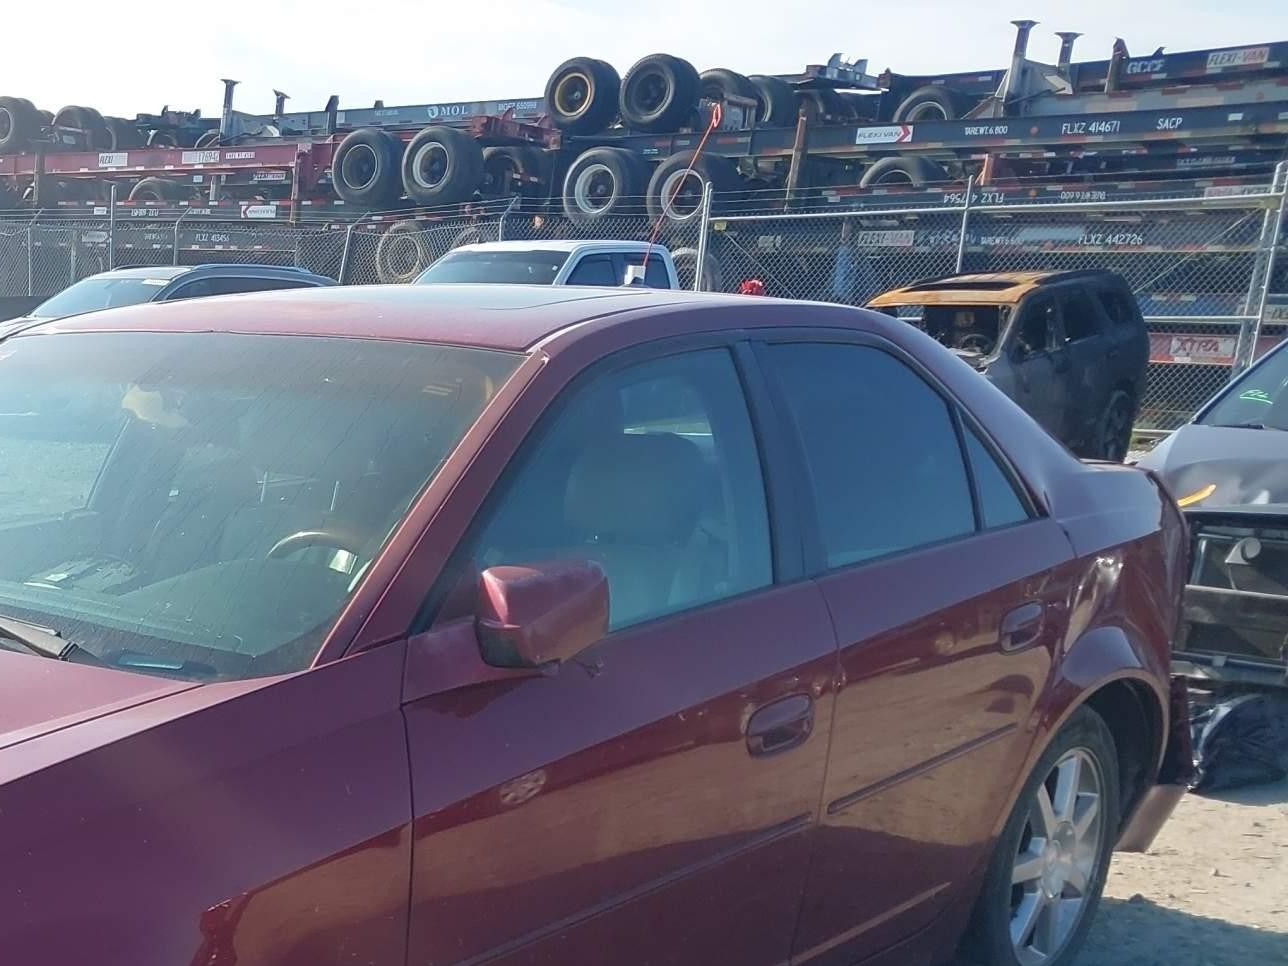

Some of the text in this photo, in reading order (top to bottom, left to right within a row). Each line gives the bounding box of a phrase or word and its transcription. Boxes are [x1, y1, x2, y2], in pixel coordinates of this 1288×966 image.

[440, 105, 469, 117] MOL
[1062, 120, 1121, 135] FLXZ 414671
[1156, 117, 1183, 131] SACP
[943, 193, 979, 204] 47564
[1103, 232, 1144, 246] 442726
